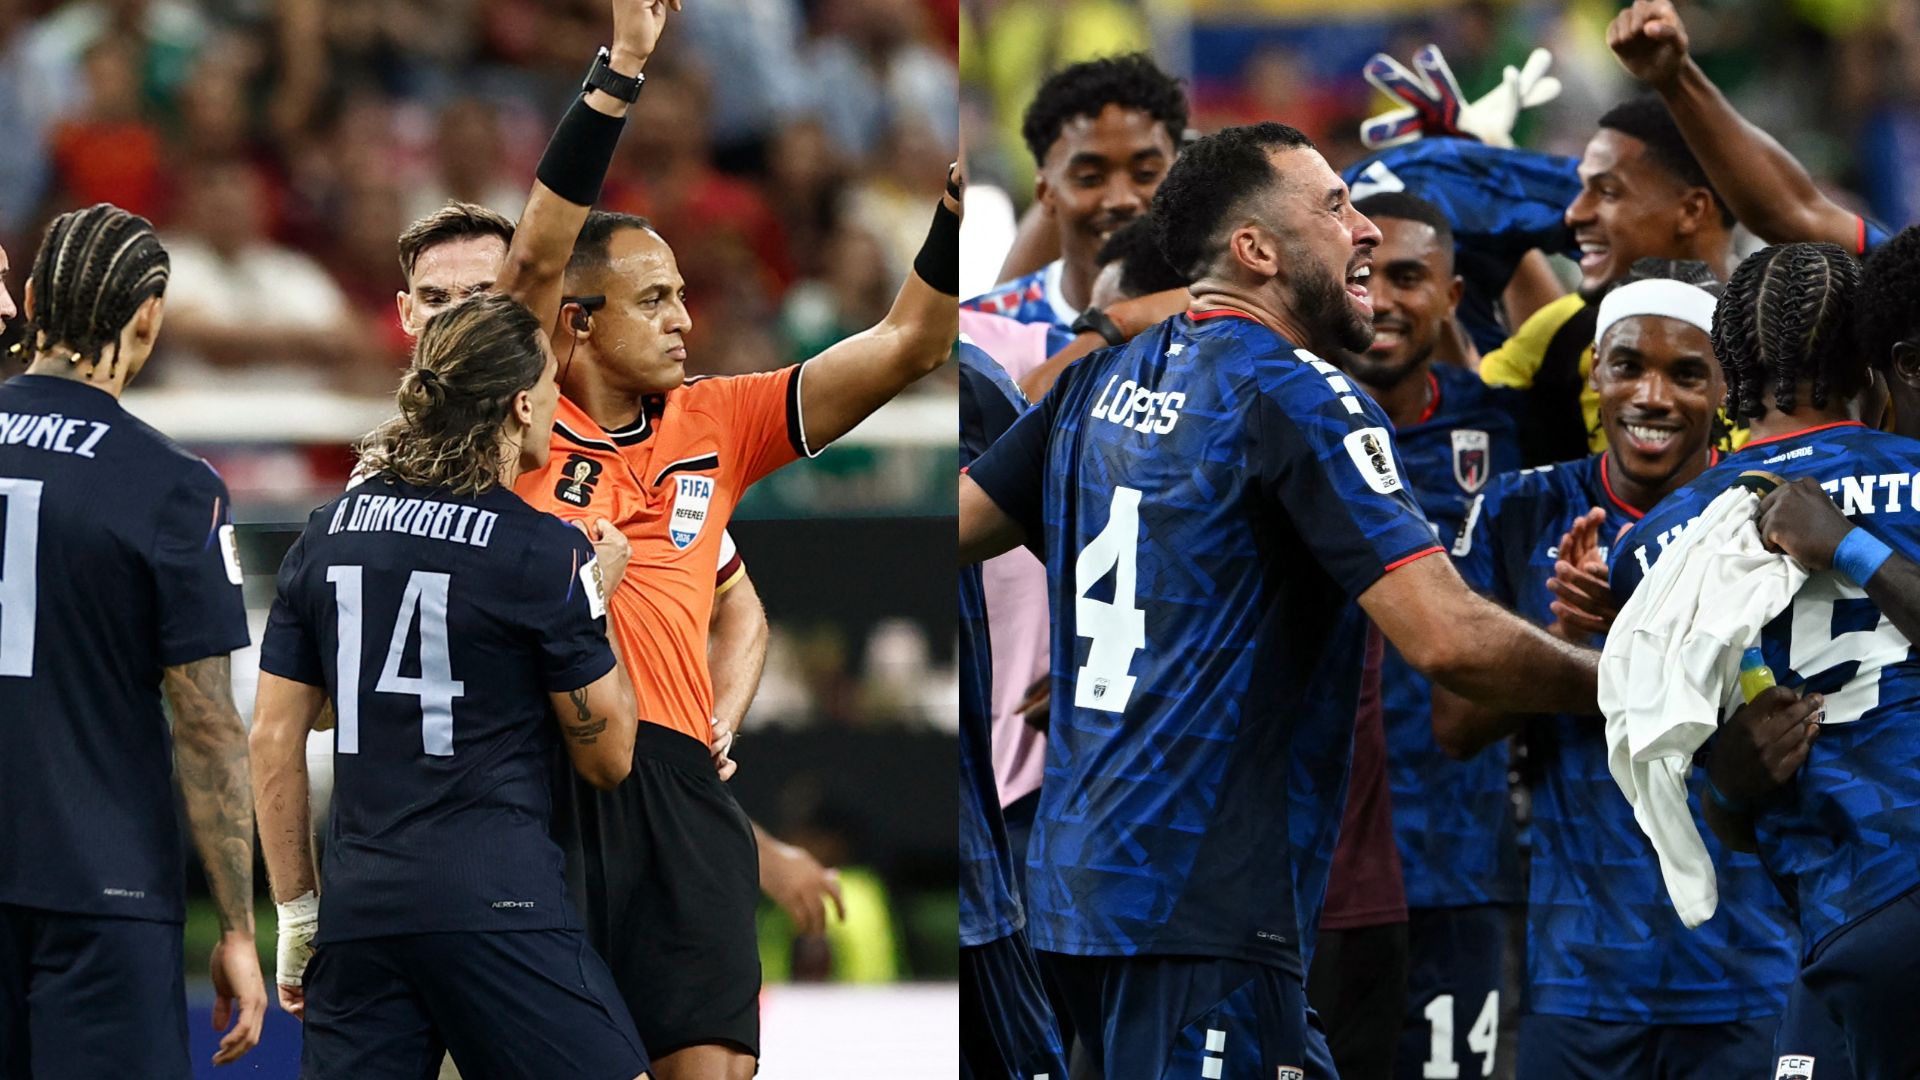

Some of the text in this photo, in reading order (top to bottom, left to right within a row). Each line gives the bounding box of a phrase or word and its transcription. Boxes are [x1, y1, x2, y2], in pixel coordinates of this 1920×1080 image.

[1091, 374, 1186, 434] LOPES
[563, 491, 581, 503] FIFA
[681, 479, 709, 499] FIFA
[676, 508, 704, 520] REFEREE
[1074, 486, 1145, 713] 4
[326, 565, 464, 756] 14
[1423, 989, 1500, 1079] 14
[1780, 1058, 1810, 1069] FCF
